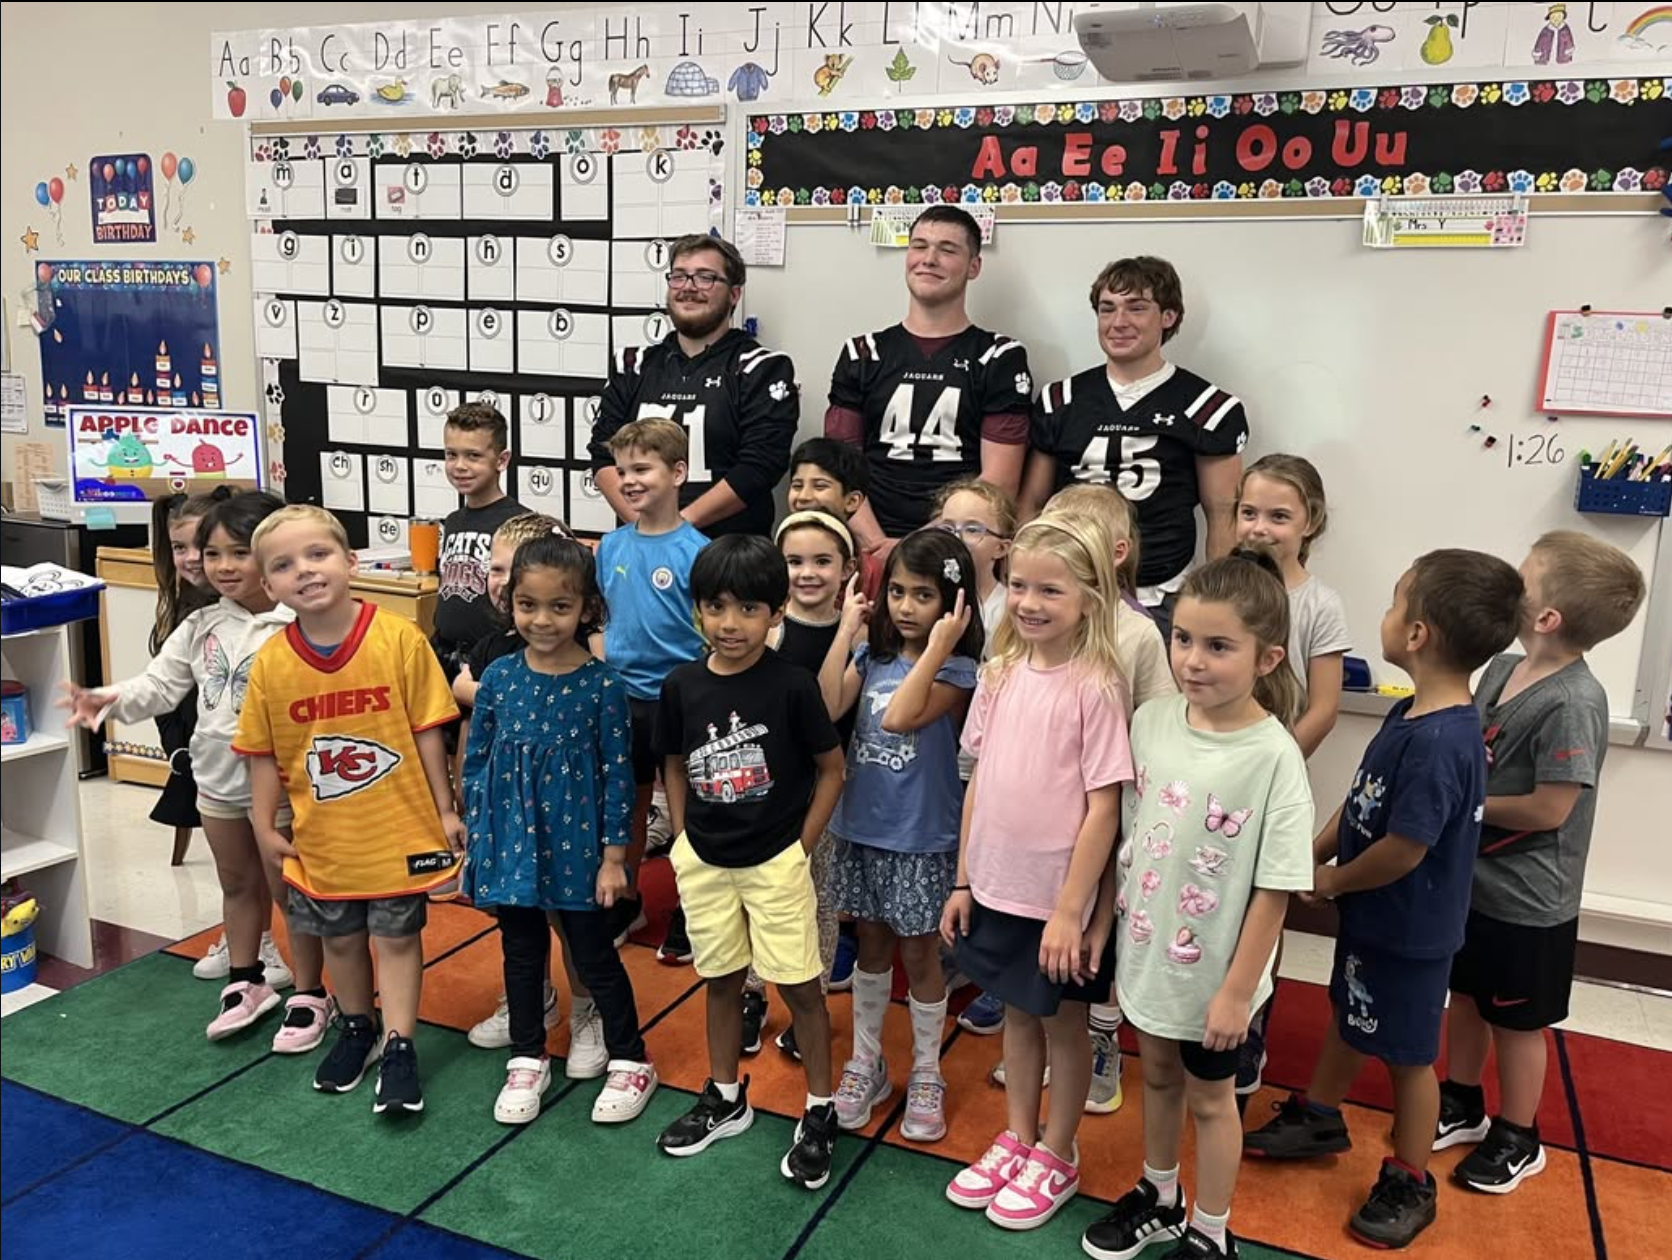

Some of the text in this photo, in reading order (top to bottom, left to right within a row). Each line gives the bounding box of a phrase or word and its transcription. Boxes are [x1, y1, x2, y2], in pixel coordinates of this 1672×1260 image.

[219, 40, 250, 77] Aa
[271, 37, 300, 74] Bb
[320, 34, 348, 73] Cc
[374, 30, 406, 70] Dd
[430, 28, 463, 68] Ee
[487, 23, 519, 66] Ff
[541, 21, 582, 86] Gg
[605, 16, 649, 59] Hh
[679, 14, 702, 56] Ii
[743, 7, 780, 76] Jj
[808, 2, 853, 48] Kk
[1032, 2, 1074, 35] N
[971, 120, 1408, 180] Aa Ee Ii Oo Uu
[276, 165, 291, 180] m
[340, 164, 352, 178] a
[577, 159, 589, 174] o
[655, 154, 667, 175] k
[412, 167, 420, 187] t
[500, 169, 512, 190] d
[97, 196, 149, 210] TODAY
[96, 225, 152, 240] BIRTHDAY
[1408, 218, 1446, 230] Mrs Y
[284, 237, 295, 255] g
[350, 238, 356, 257] i
[414, 243, 426, 256] n
[484, 241, 494, 260] h
[556, 242, 565, 259] s
[58, 269, 190, 285] OUR CLASS BIRTHDAYS
[271, 305, 281, 320] v
[330, 307, 339, 321] z
[416, 311, 428, 330] p
[483, 314, 495, 329] e
[555, 313, 568, 332] b
[903, 371, 944, 381] JAGUARS
[537, 397, 545, 421] j
[879, 383, 963, 461] 44
[1508, 433, 1565, 468] 1:26
[332, 456, 349, 470] ch
[379, 460, 394, 473] sh
[1070, 435, 1161, 501] 45
[530, 475, 550, 489] qu
[446, 532, 492, 561] CATS
[289, 686, 391, 724] CHIEFS
[318, 746, 378, 781] KC
